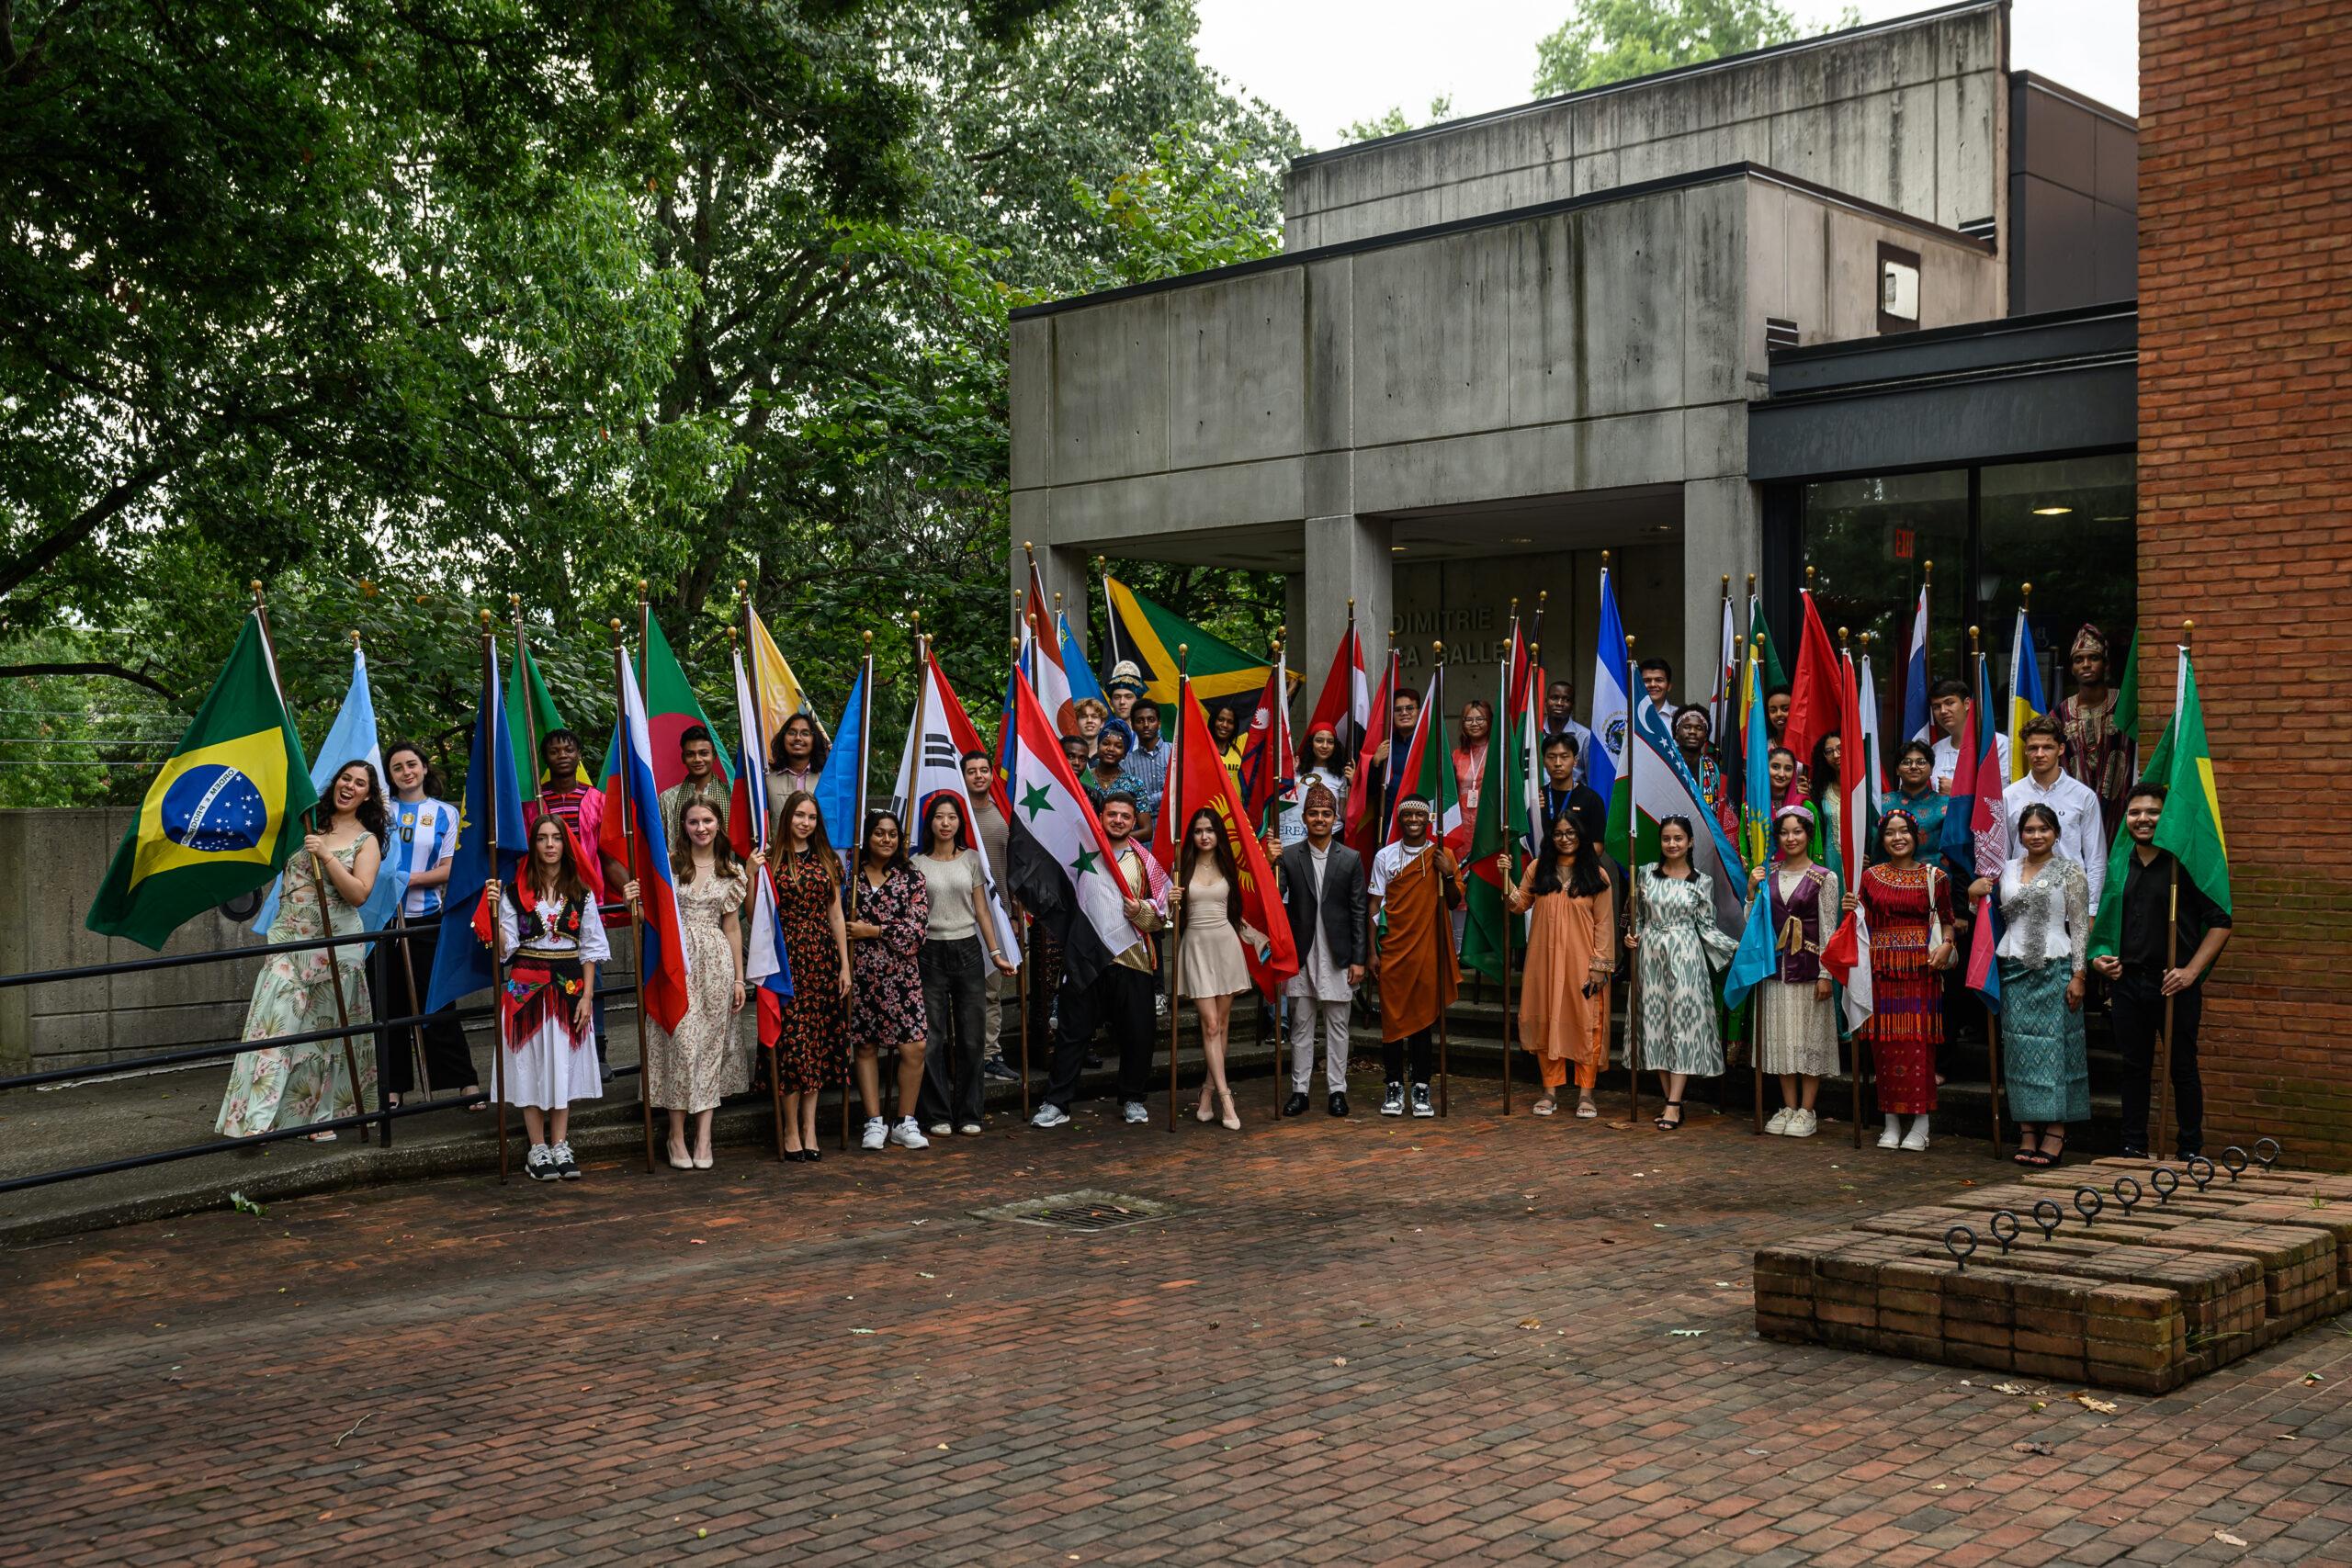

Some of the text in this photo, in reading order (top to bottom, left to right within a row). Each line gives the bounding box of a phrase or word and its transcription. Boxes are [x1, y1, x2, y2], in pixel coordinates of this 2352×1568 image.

[1895, 528, 1915, 558] EXIT
[1394, 607, 1493, 634] DIMITRIE
[1433, 640, 1505, 666] GALLE
[400, 826, 413, 843] 10
[1279, 824, 1308, 837] EREA
